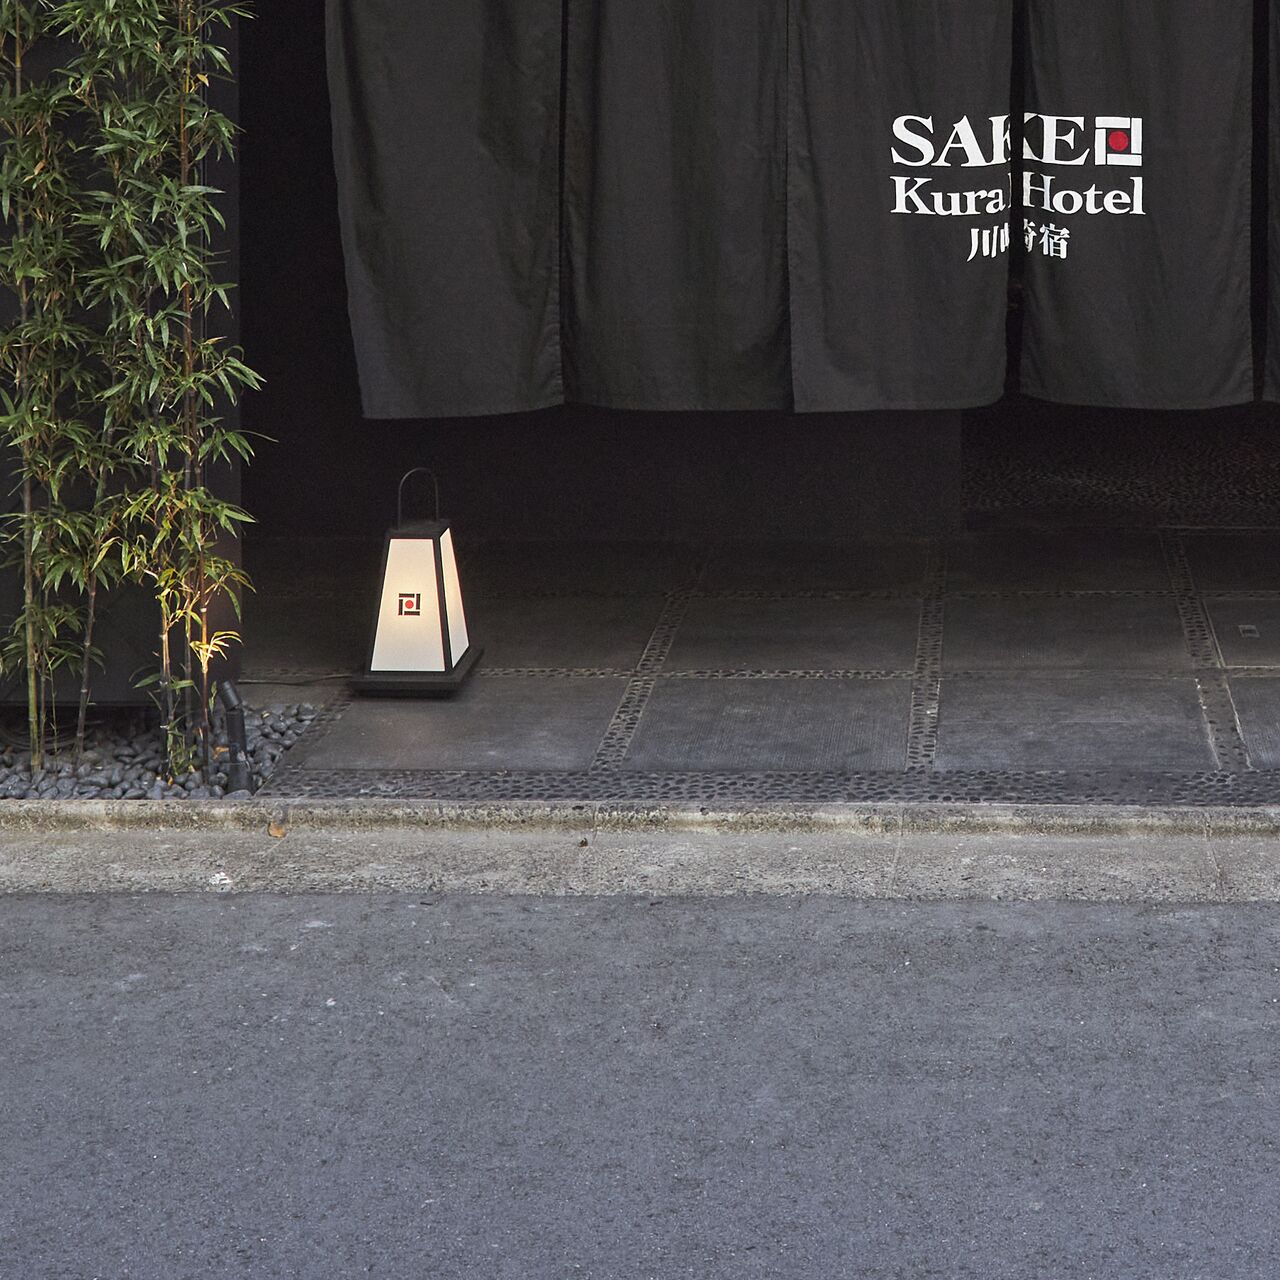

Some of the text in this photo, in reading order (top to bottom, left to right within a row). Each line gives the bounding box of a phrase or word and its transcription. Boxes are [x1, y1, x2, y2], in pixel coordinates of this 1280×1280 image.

[890, 113, 1090, 167] SAKE
[889, 172, 1147, 216] Kura Hotel
